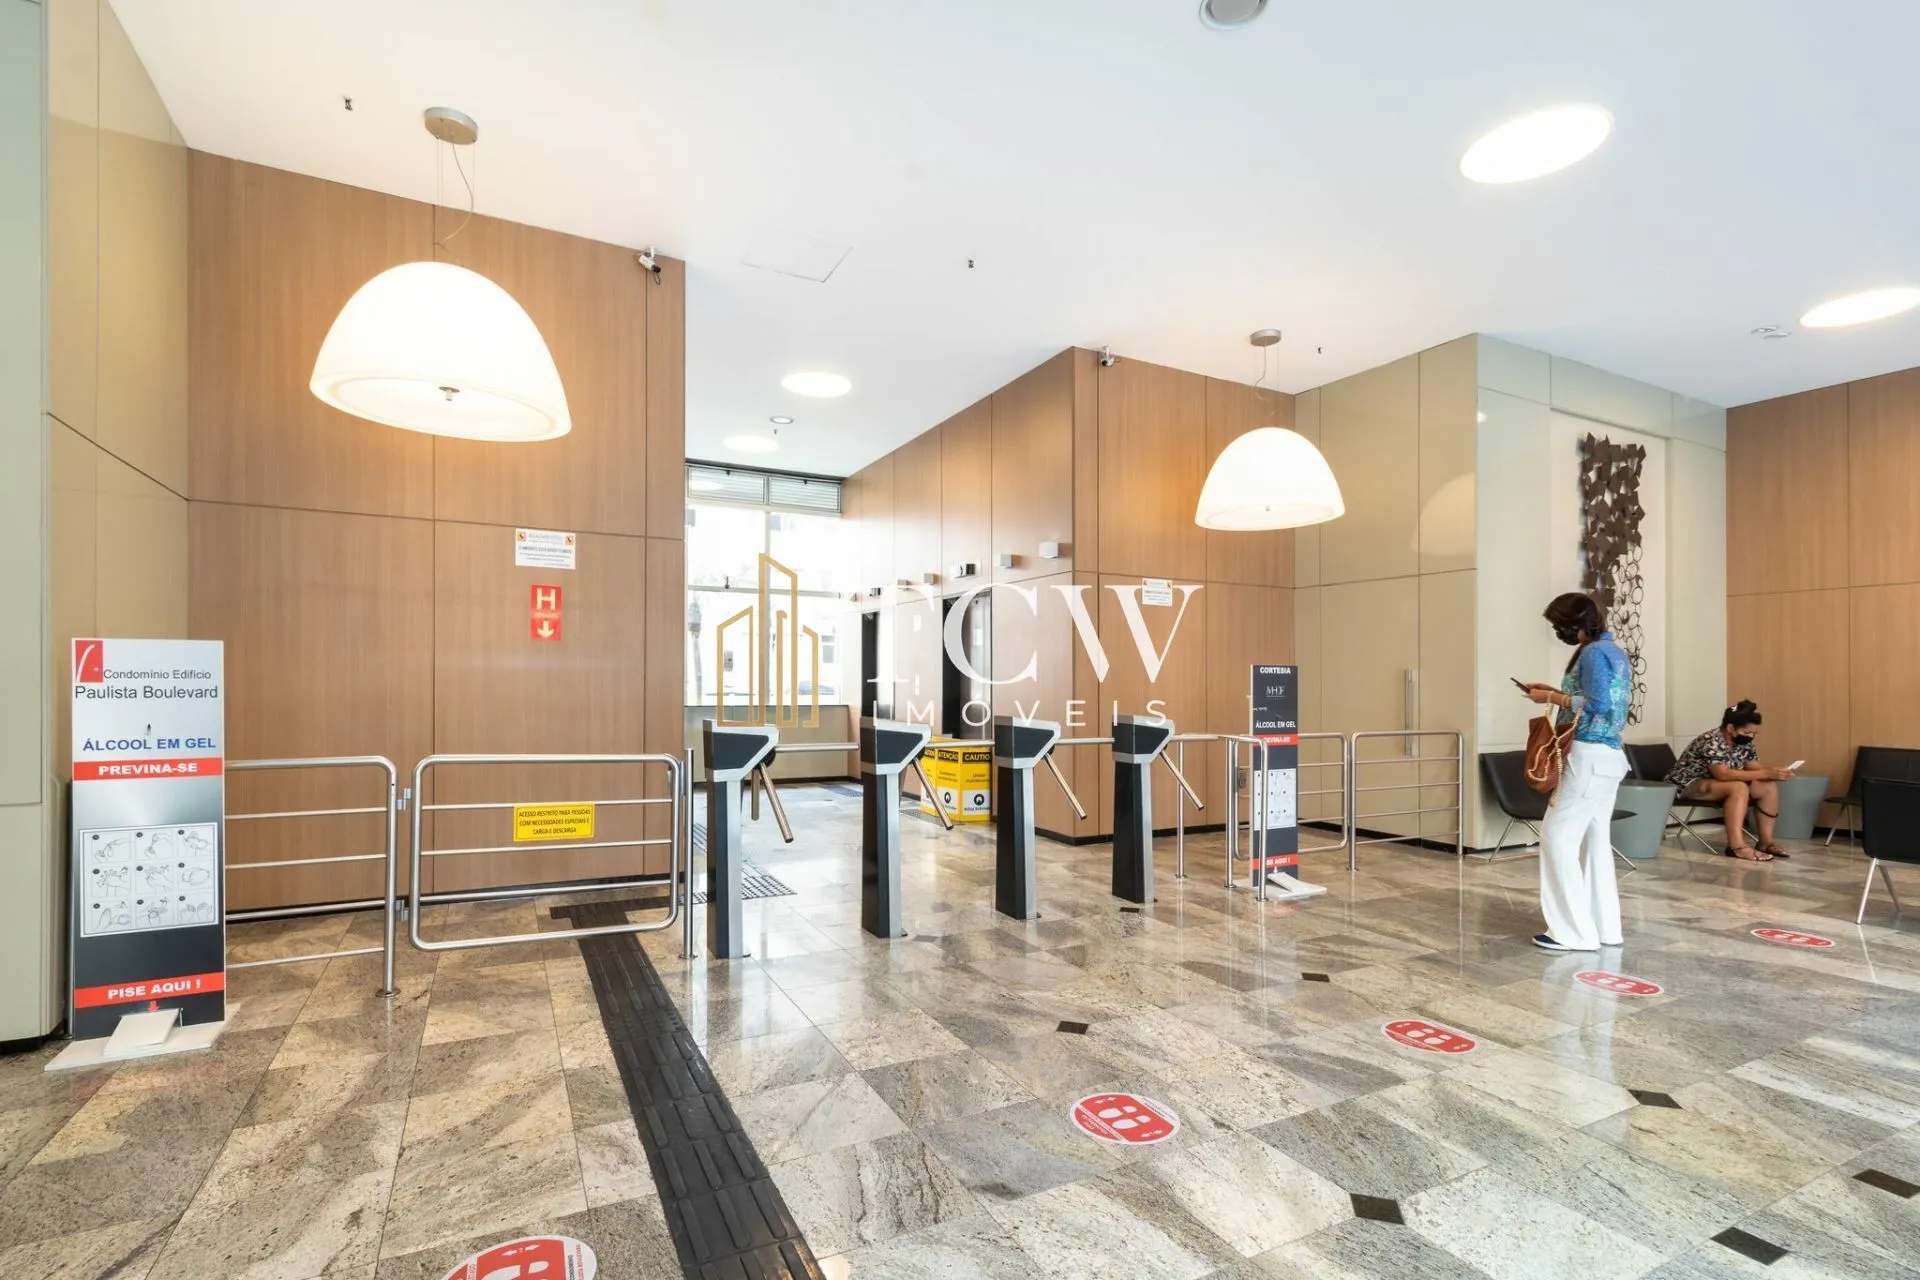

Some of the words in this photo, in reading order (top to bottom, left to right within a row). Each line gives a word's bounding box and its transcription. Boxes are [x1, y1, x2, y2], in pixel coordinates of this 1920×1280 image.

[536, 588, 556, 610] H
[75, 685, 137, 699] Paulista
[143, 685, 218, 699] Boulevard
[1255, 720, 1277, 729] ÁLCOOL
[83, 738, 152, 751] ÁLCOOL
[157, 738, 180, 749] EM
[185, 738, 216, 749] GEL
[964, 753, 991, 761] CAUTIO
[98, 763, 198, 775] PREVINA-SE
[107, 986, 146, 999] PISE
[151, 981, 191, 994] AQUI
[195, 979, 201, 989] !
